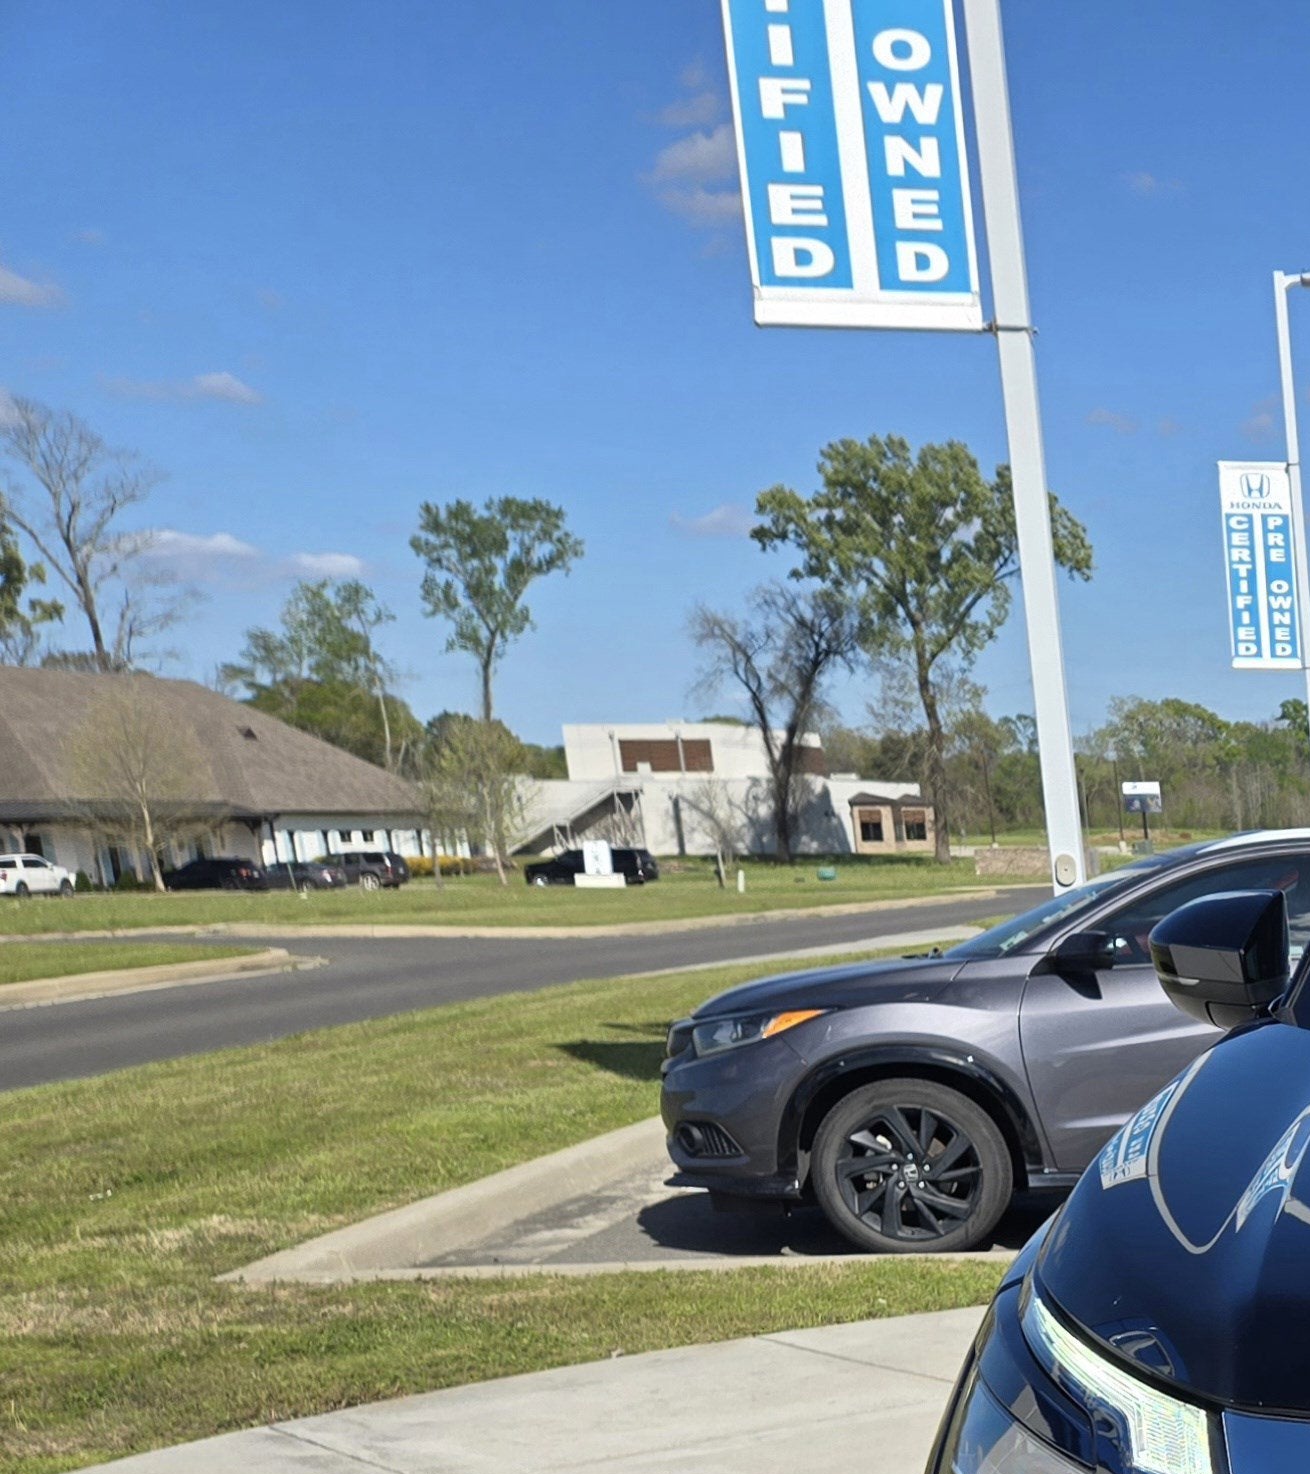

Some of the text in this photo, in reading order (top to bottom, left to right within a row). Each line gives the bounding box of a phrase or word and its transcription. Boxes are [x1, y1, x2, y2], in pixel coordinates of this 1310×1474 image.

[867, 28, 949, 282] OWNED
[1229, 501, 1283, 510] HONDA
[1228, 515, 1258, 656] CERTIFIED
[1266, 516, 1293, 657] PRE OWNED
